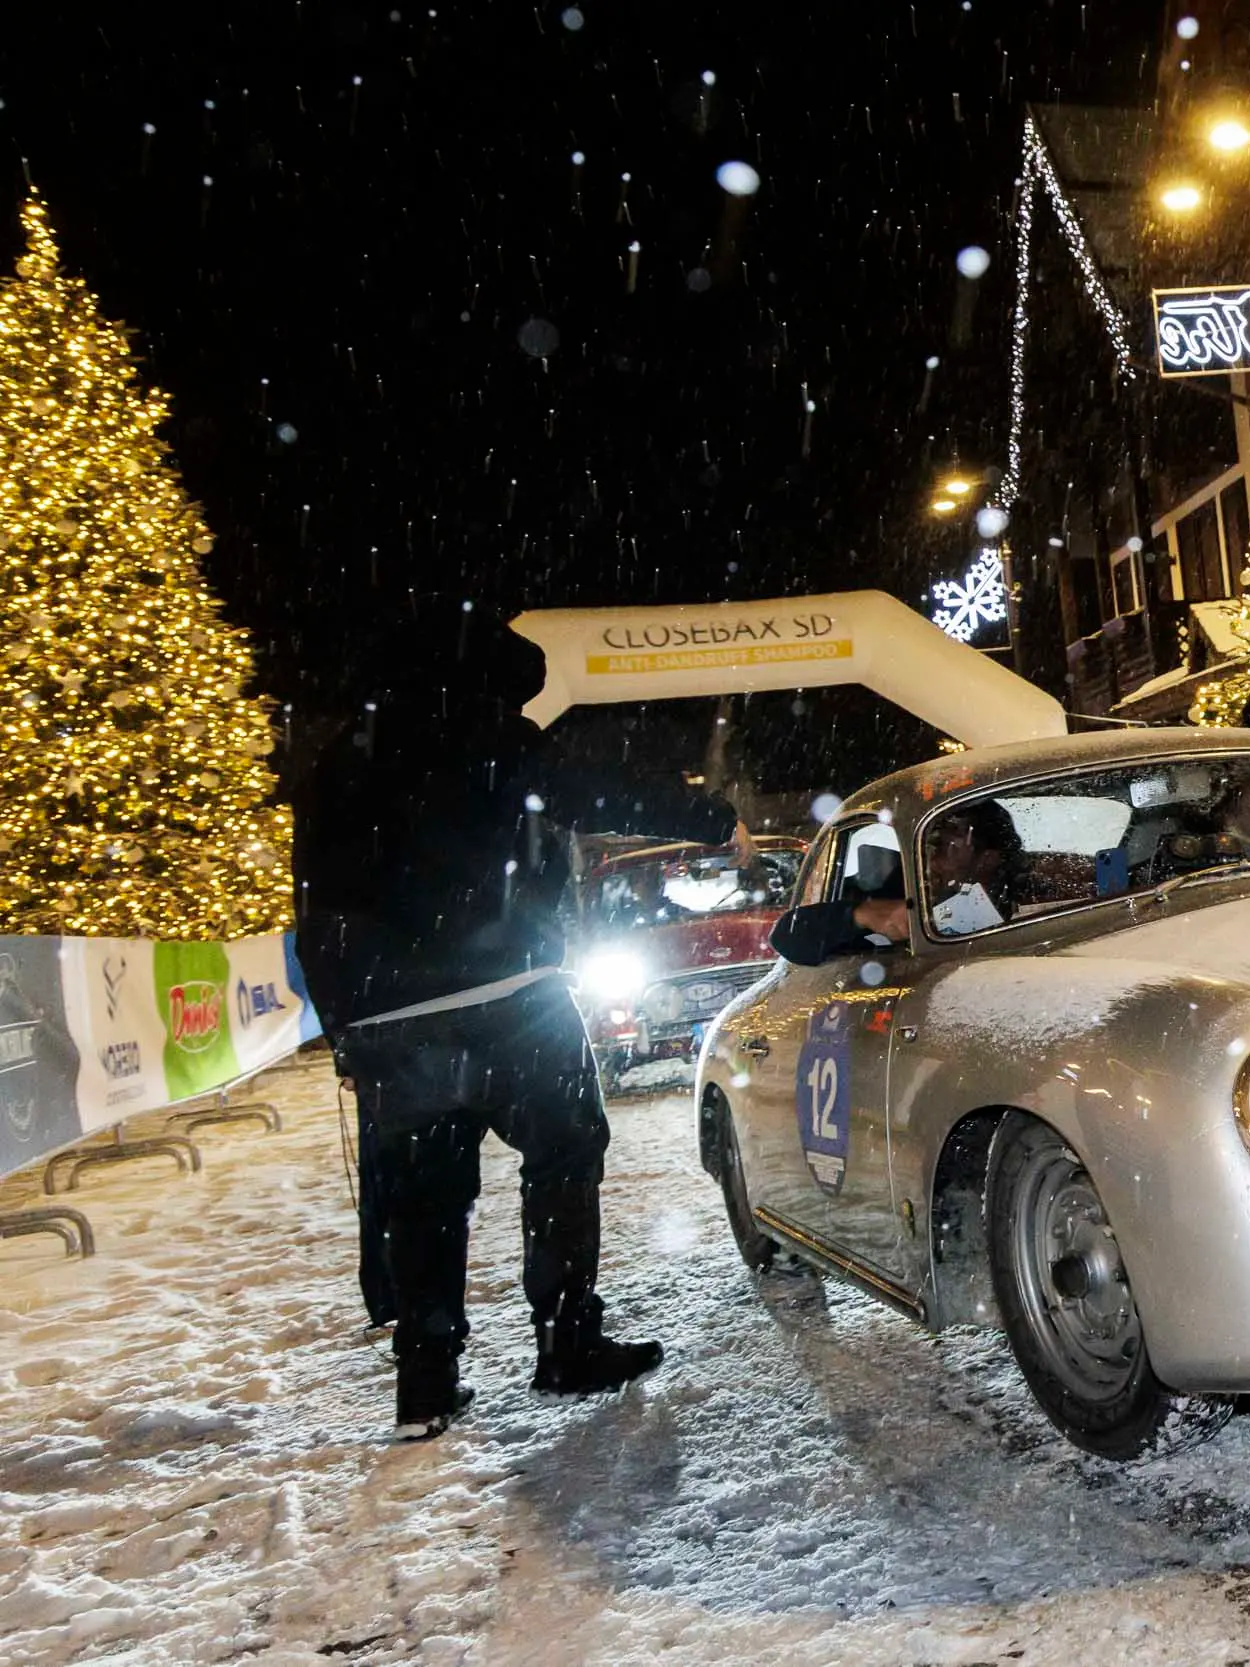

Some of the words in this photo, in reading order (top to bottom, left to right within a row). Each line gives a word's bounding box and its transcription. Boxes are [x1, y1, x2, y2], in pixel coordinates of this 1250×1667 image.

[603, 617, 780, 649] CLOSEBAX
[793, 613, 832, 638] SD
[608, 651, 748, 671] ANTI-DANDRUFF
[753, 644, 837, 660] SHAMPOO
[808, 1057, 838, 1140] 12
